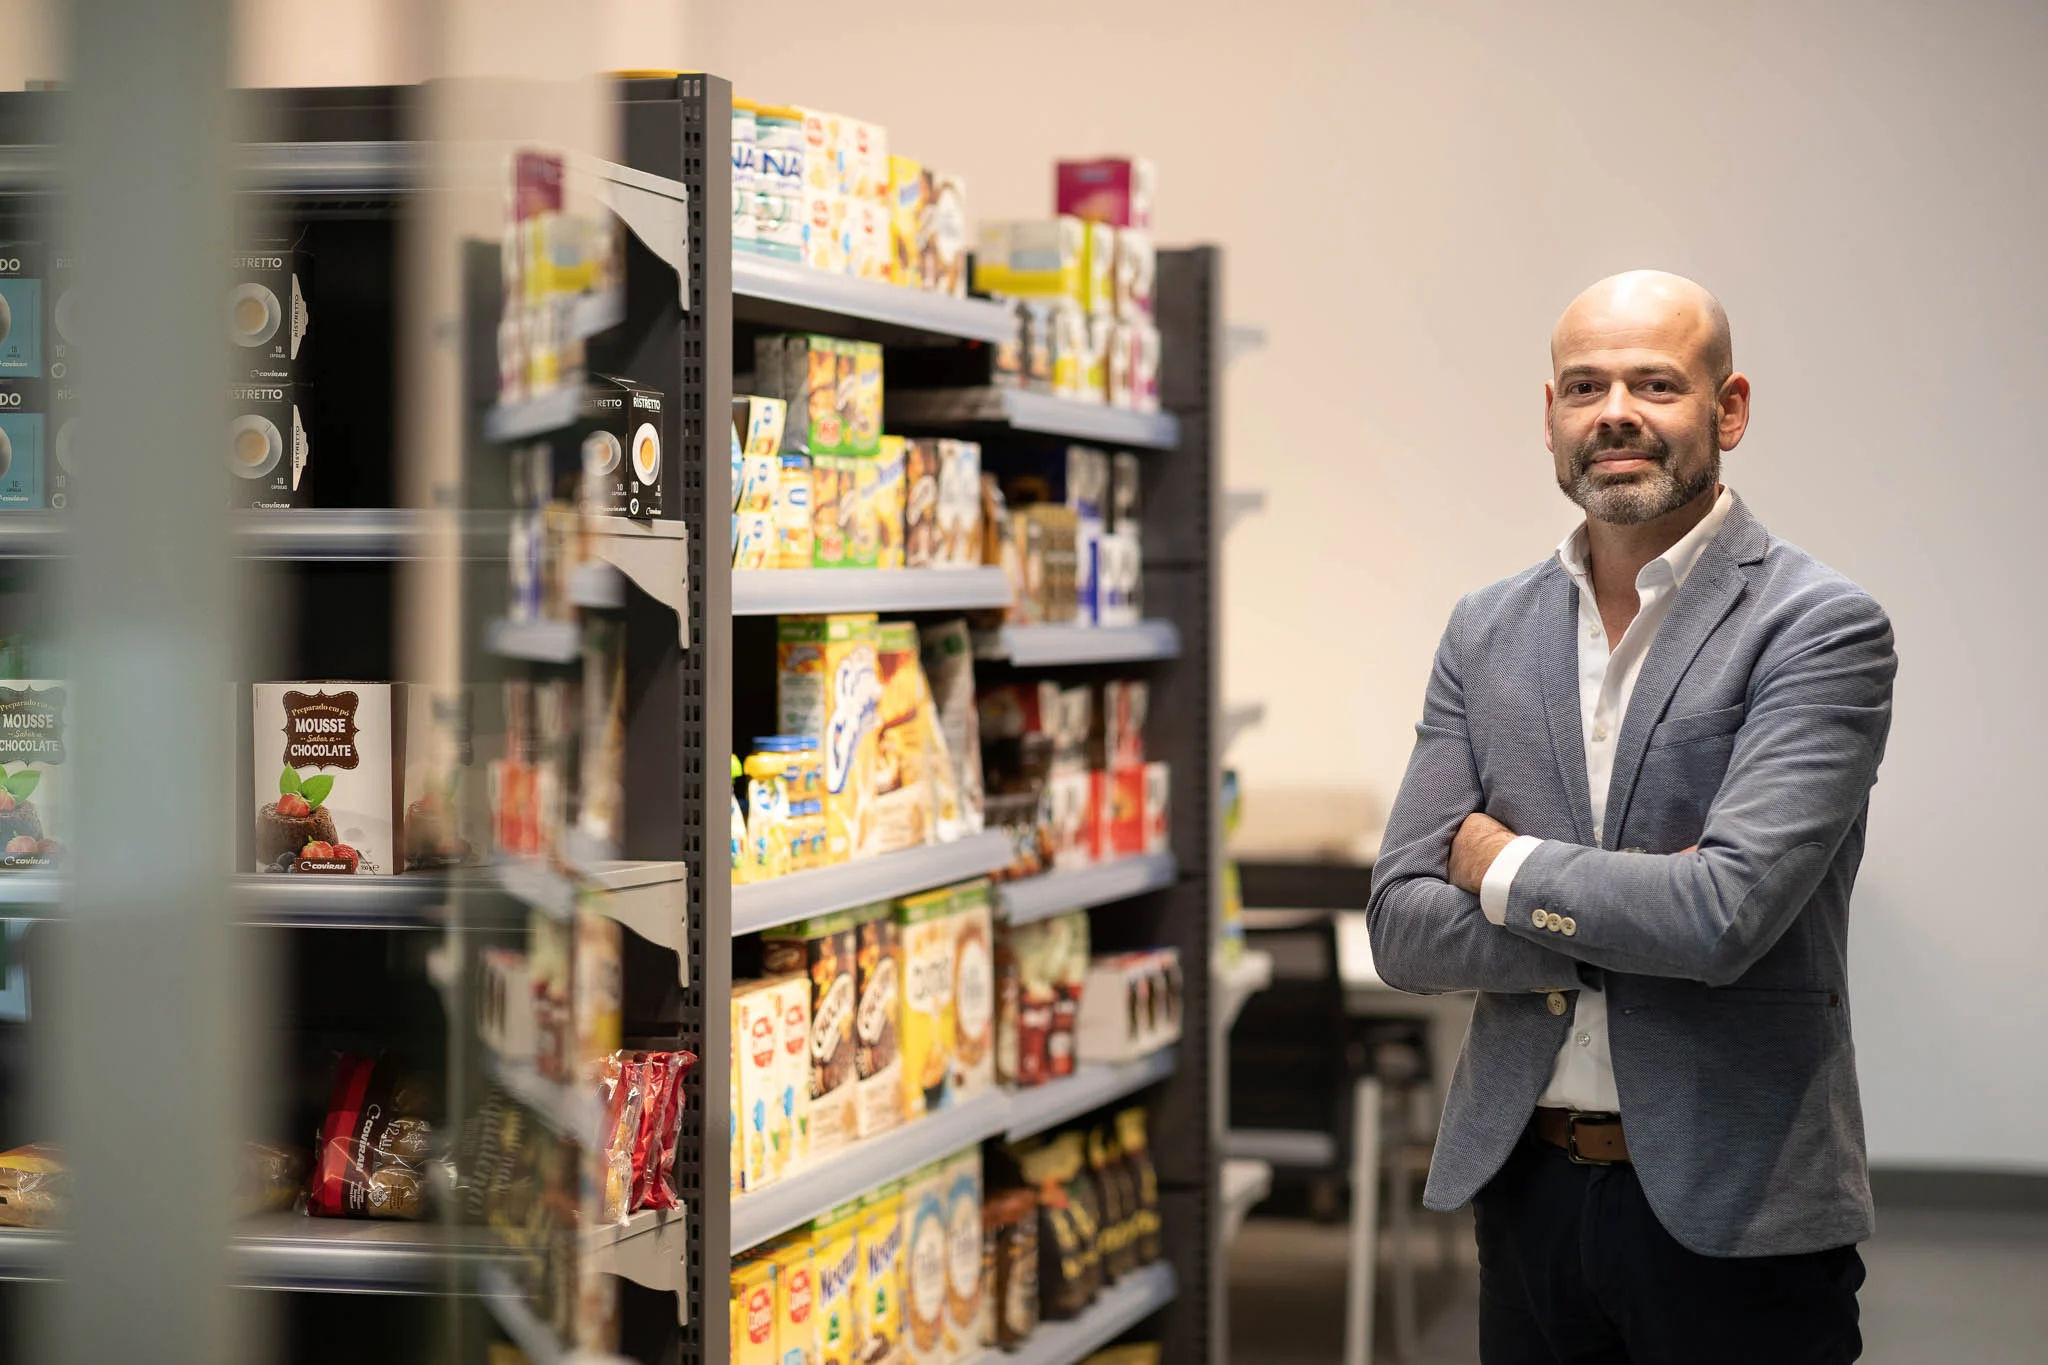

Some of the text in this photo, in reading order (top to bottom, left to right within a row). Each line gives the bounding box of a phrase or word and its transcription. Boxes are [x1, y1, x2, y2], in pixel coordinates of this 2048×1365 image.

[633, 397, 661, 410] RISTRETTO
[291, 703, 328, 717] Preparado
[328, 705, 340, 713] em
[3, 714, 54, 728] MOUSSE
[295, 718, 346, 733] MOUSSE
[306, 734, 328, 743] Sabor
[0, 739, 60, 752] CHOCOLATE
[290, 744, 351, 757] CHOCOLATE
